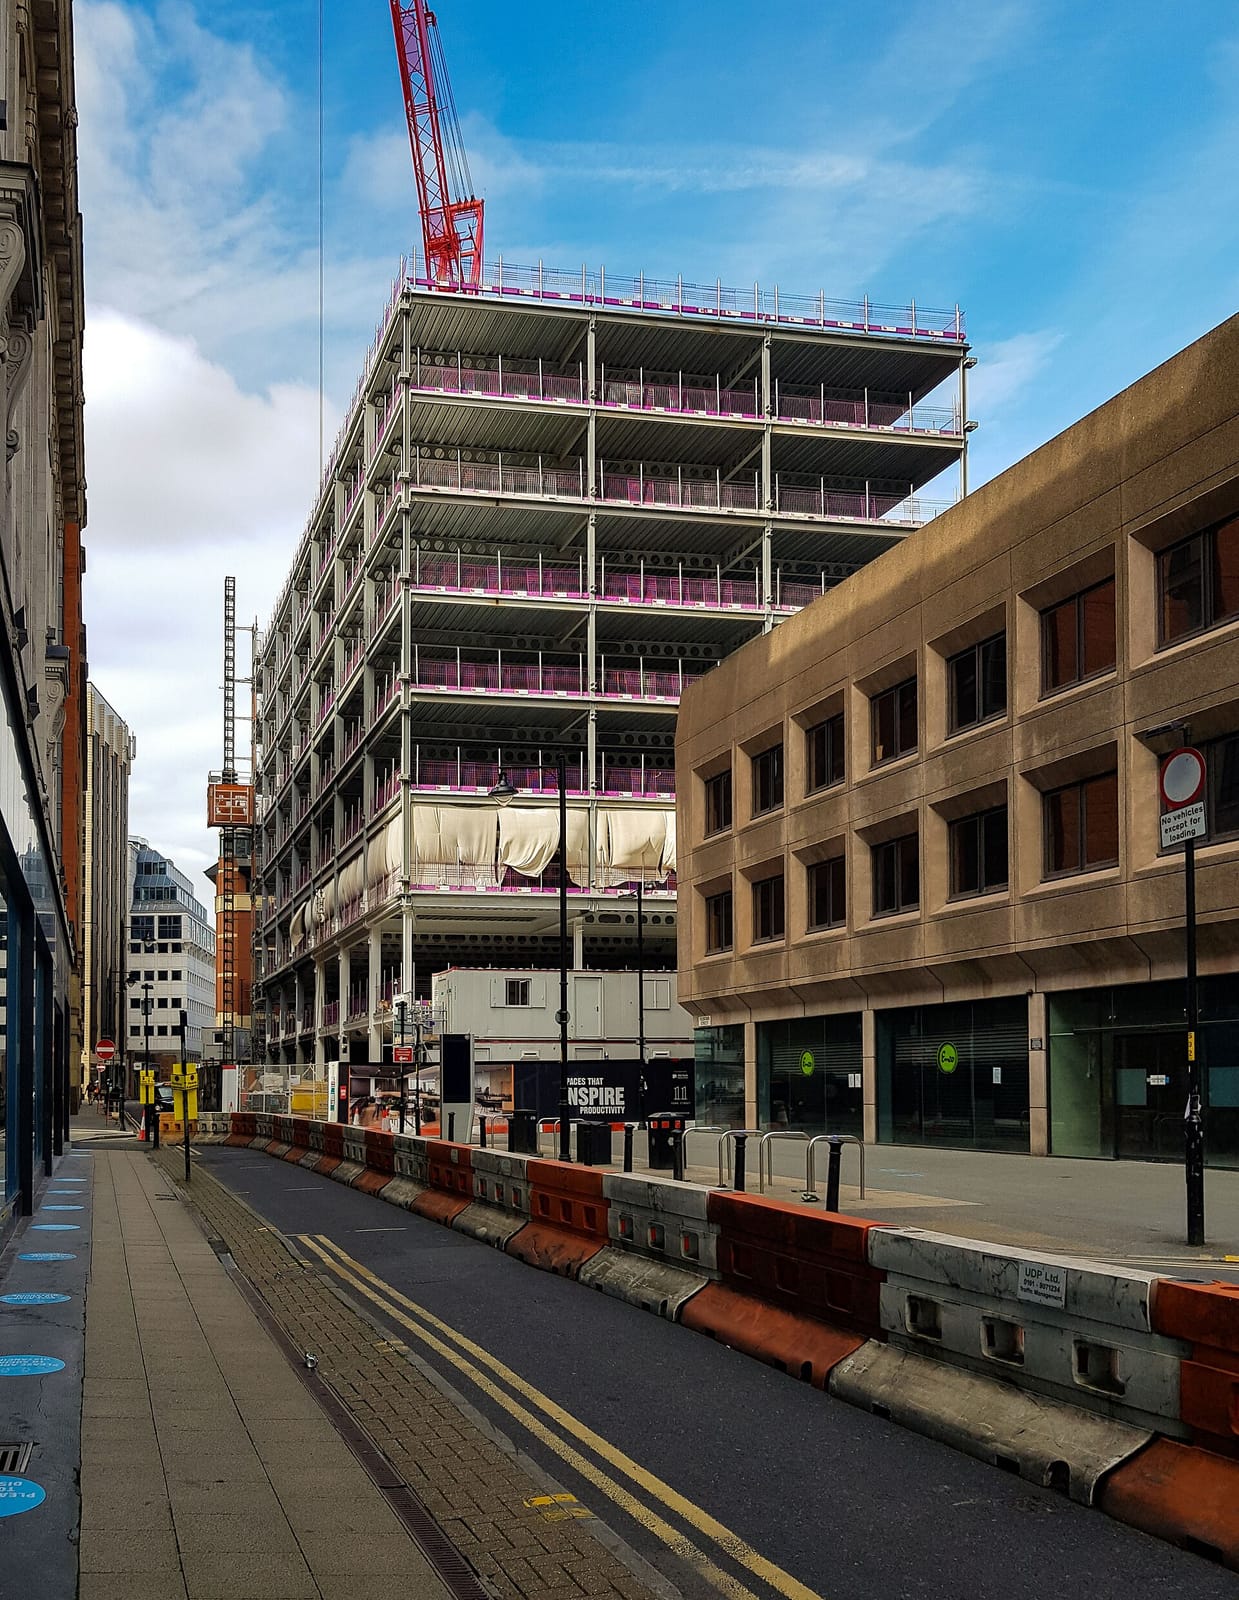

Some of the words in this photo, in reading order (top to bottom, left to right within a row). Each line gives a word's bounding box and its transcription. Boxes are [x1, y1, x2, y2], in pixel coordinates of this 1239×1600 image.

[1161, 816, 1172, 825] No
[1172, 806, 1203, 821] vehicles
[1164, 820, 1188, 834] except
[1190, 816, 1201, 825] for
[1169, 828, 1196, 842] loading
[566, 1077, 586, 1086] PACES
[587, 1077, 604, 1086] THAT
[567, 1087, 625, 1106] NSPIRE
[579, 1106, 626, 1115] PRODUCTIVITY
[1025, 1267, 1043, 1279] UDP
[1044, 1271, 1061, 1284] Ltd.
